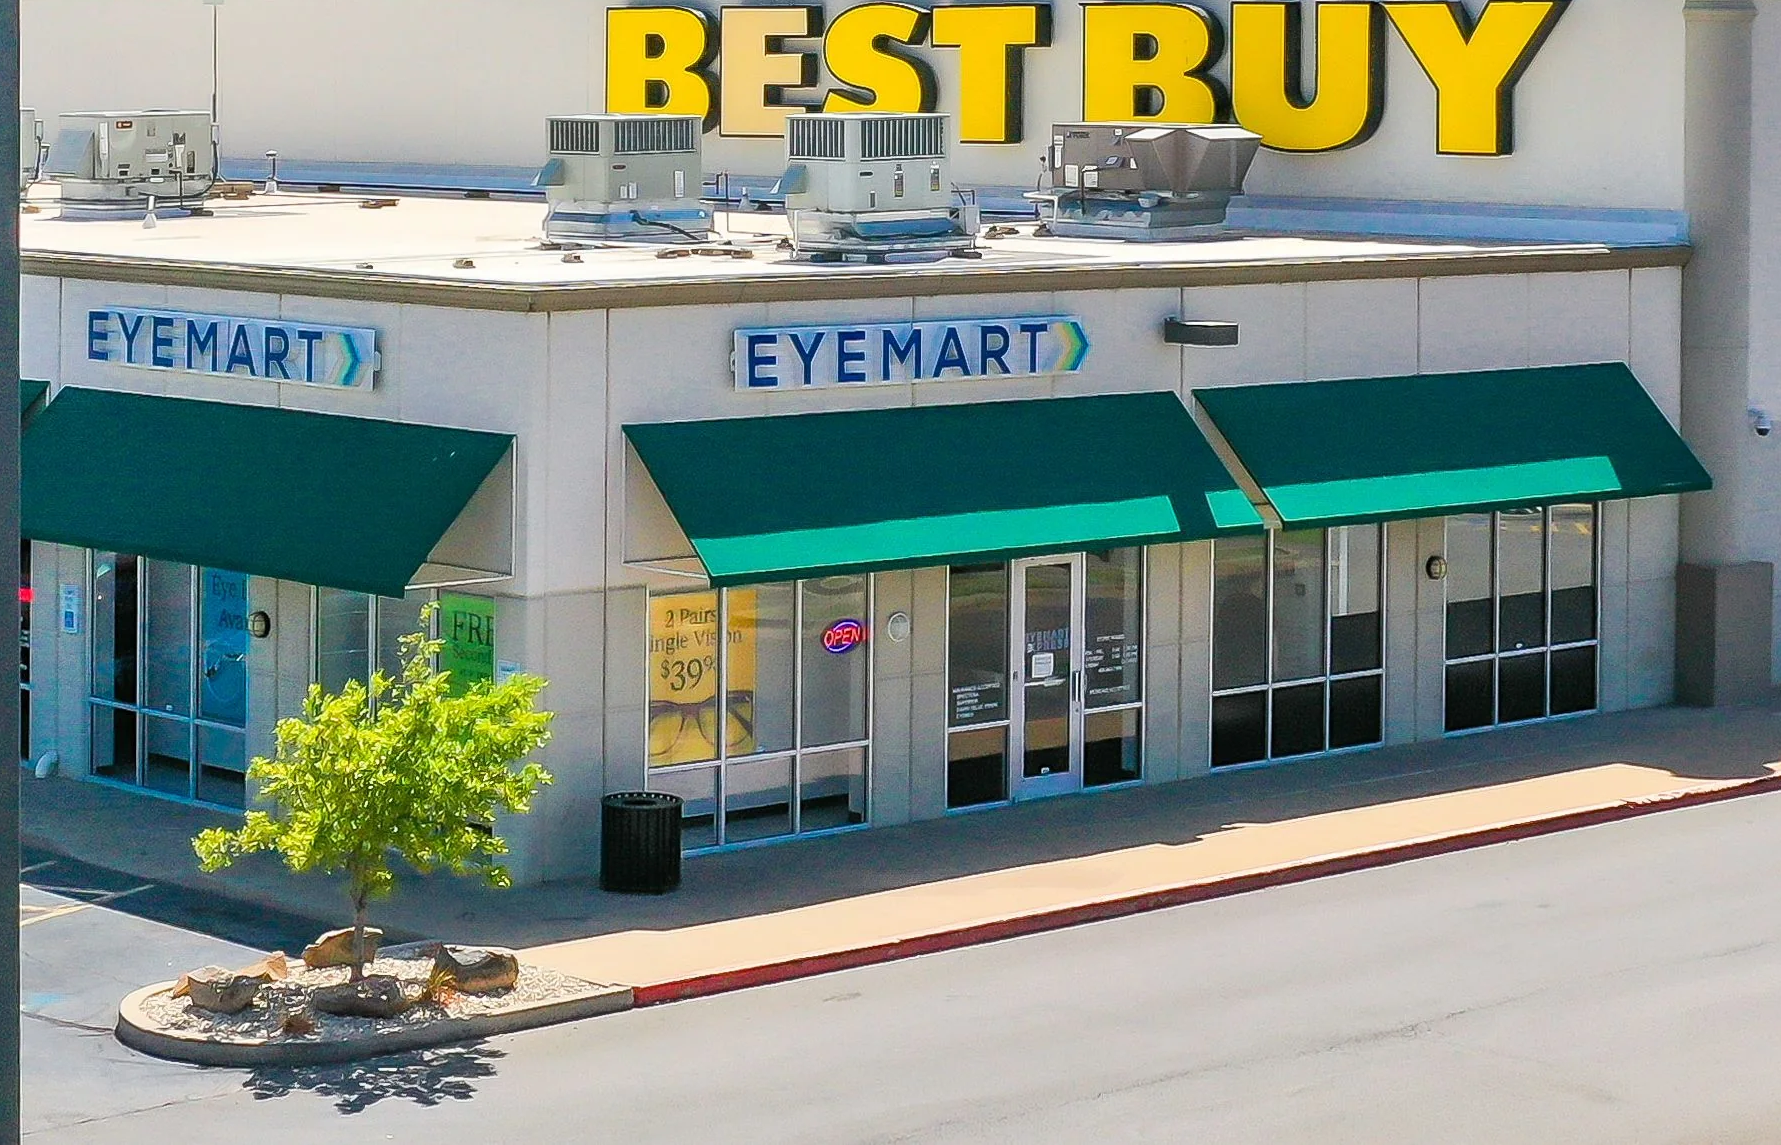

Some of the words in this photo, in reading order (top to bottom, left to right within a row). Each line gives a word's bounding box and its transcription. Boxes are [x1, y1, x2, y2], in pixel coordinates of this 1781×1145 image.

[606, 2, 1052, 144] BEST
[88, 310, 323, 384] EYEMART
[746, 323, 1048, 388] EYEMART
[665, 609, 674, 628] 2
[680, 608, 716, 625] Pairs
[824, 627, 861, 646] OPEN
[650, 631, 688, 654] ingle
[693, 629, 743, 648] Visn
